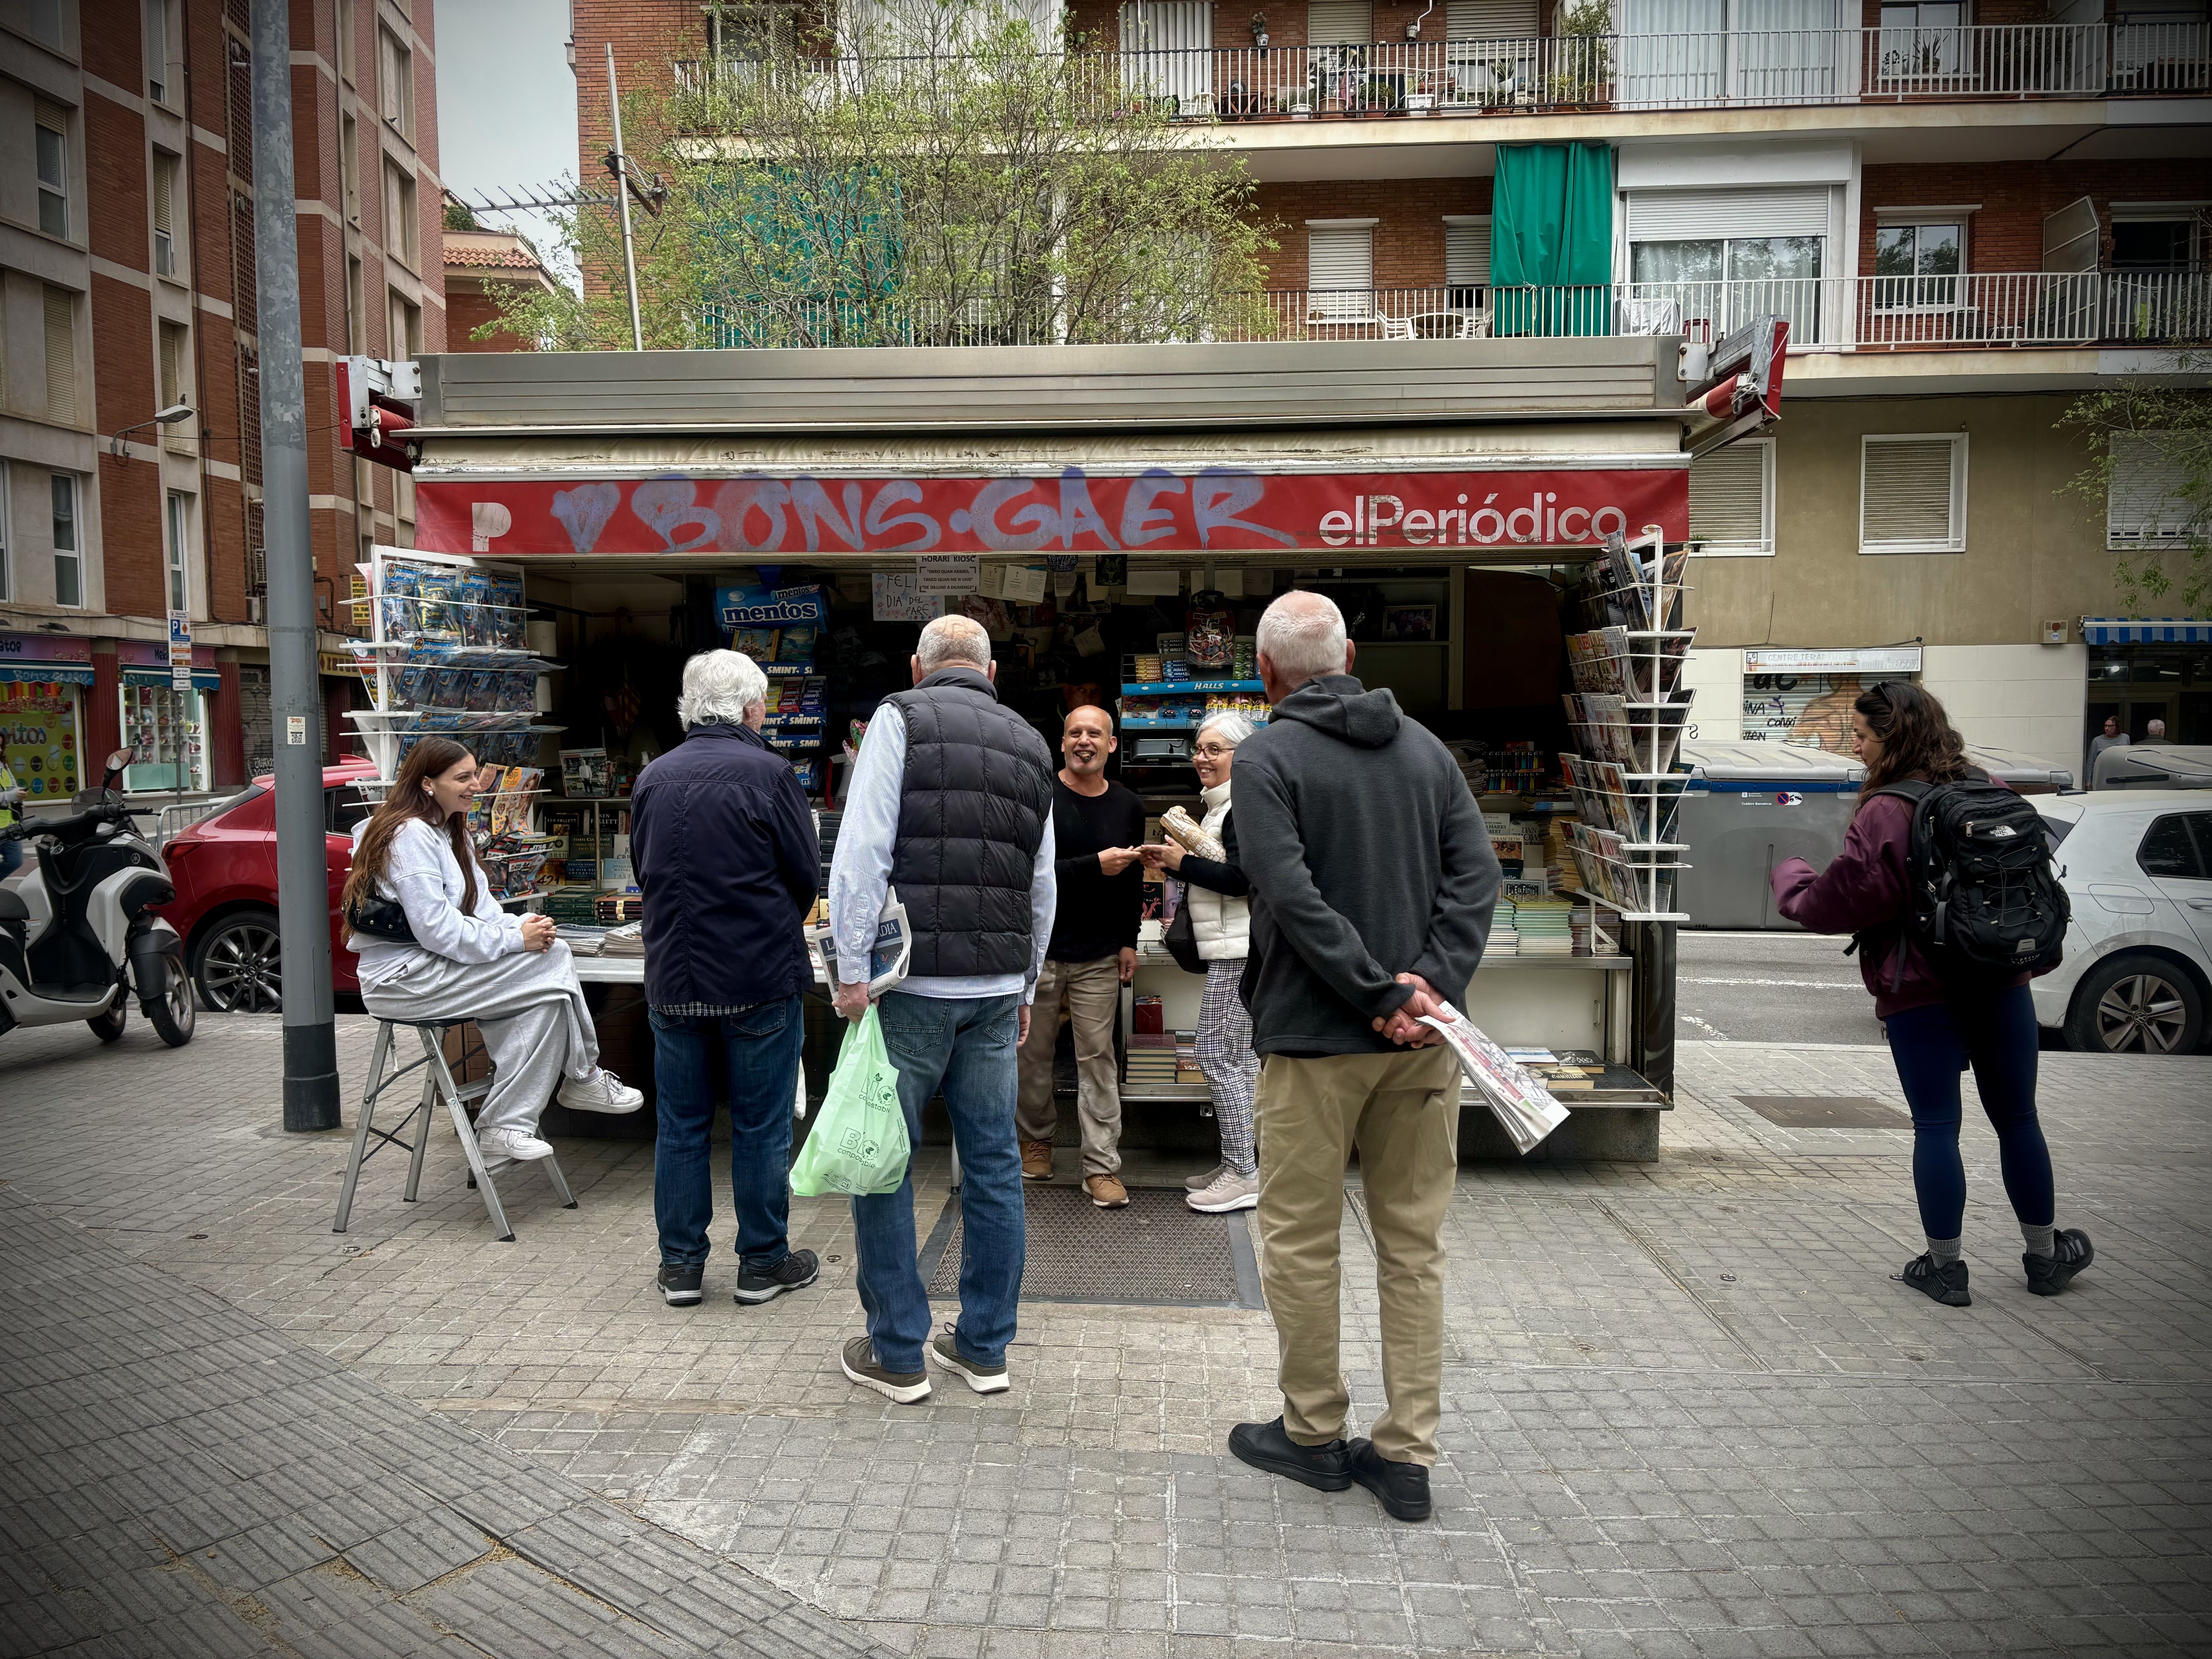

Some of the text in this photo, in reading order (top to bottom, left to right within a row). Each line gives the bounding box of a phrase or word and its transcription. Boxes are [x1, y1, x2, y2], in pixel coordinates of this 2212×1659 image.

[1319, 492, 1627, 547] elPeriódico
[395, 570, 417, 580] playmo
[887, 575, 917, 590] FELI
[777, 586, 810, 599] mentos
[723, 601, 818, 623] mentos
[906, 604, 929, 616] PARE
[172, 621, 178, 634] P
